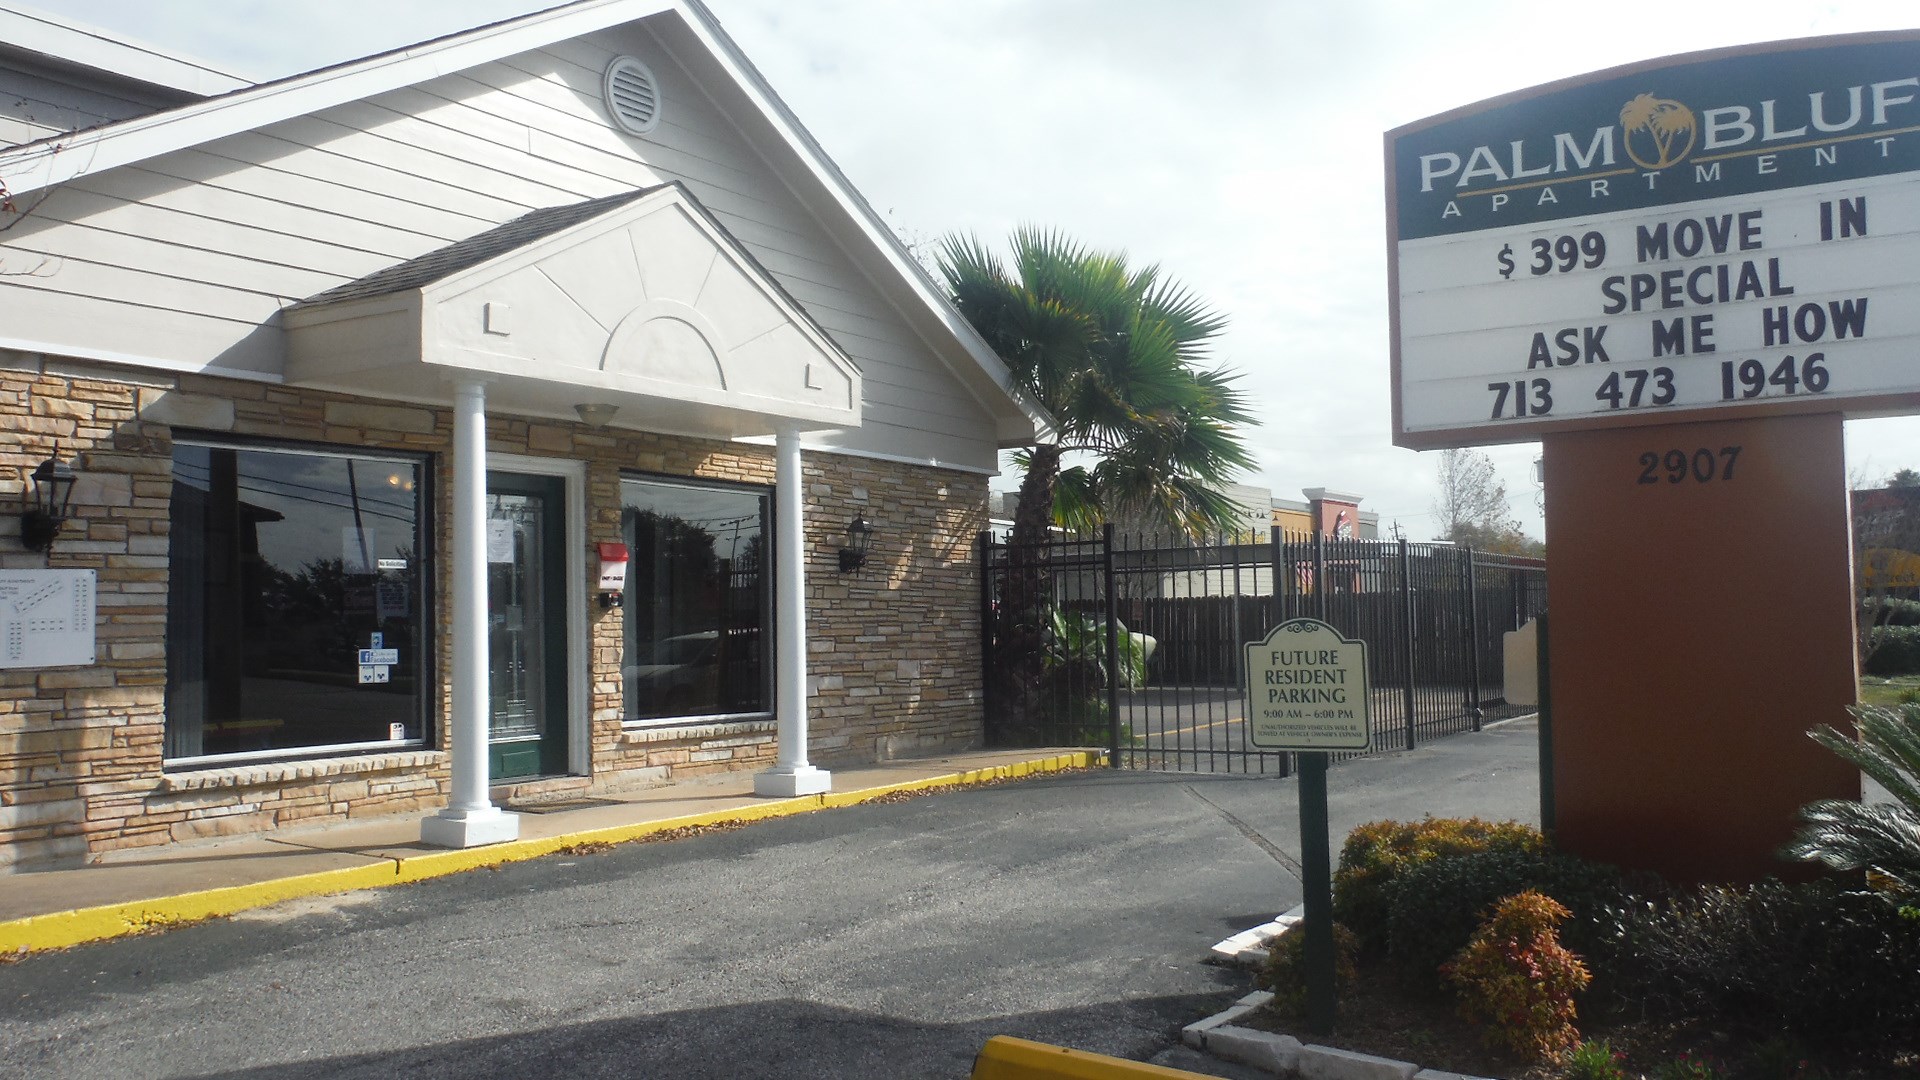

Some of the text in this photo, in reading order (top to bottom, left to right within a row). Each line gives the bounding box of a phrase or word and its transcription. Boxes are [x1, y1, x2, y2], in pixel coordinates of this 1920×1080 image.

[1419, 126, 1616, 192] PALM
[1637, 209, 1763, 263] MOVE
[1819, 196, 1868, 242] IN
[1601, 257, 1795, 315] SPECIAL
[1526, 297, 1868, 370] ASK ME HOW
[1488, 352, 1830, 420] 713 473 1946
[1637, 446, 1743, 486] 2907
[1265, 669, 1347, 684] RESIDENT
[1271, 650, 1339, 666] FUTURE
[1263, 709, 1284, 719] 9:00
[1286, 709, 1302, 719] AM
[1314, 709, 1335, 719] 6:00
[1338, 709, 1354, 719] PM
[1268, 688, 1346, 704] PARKING
